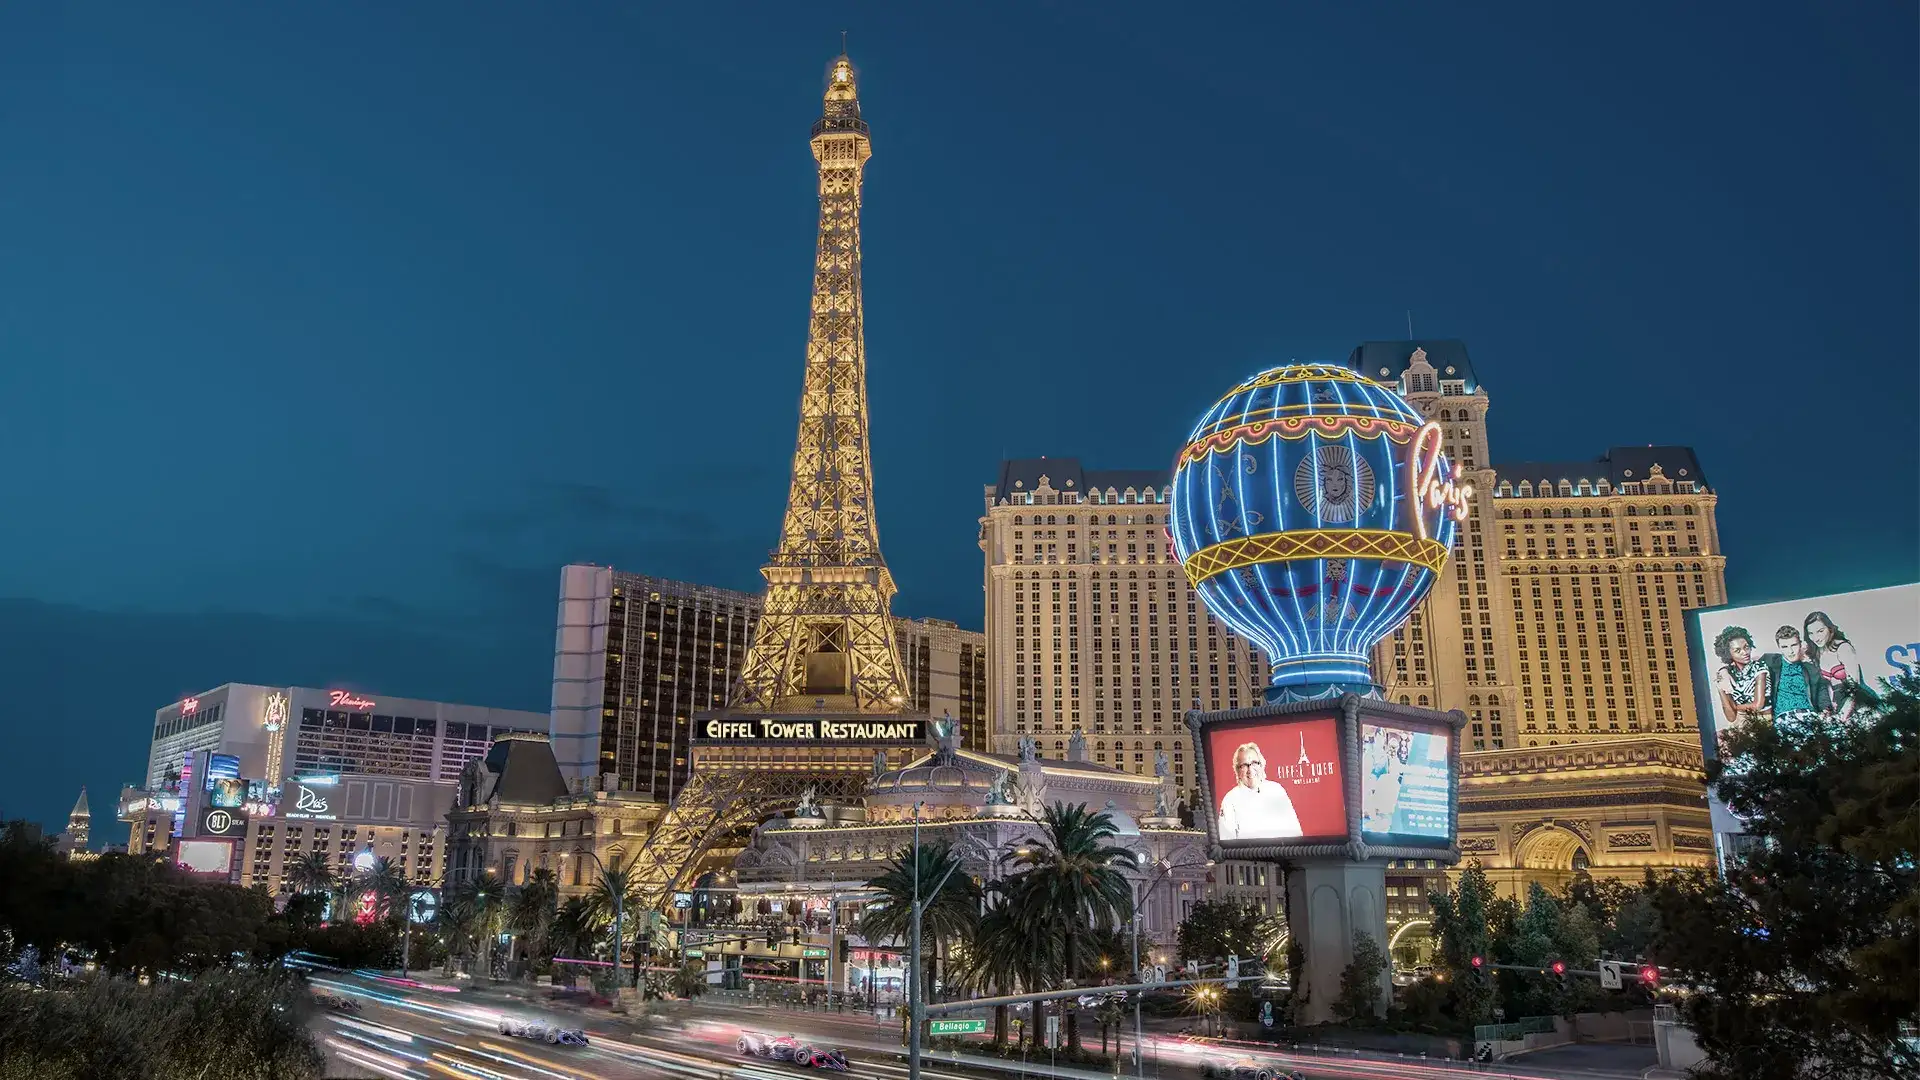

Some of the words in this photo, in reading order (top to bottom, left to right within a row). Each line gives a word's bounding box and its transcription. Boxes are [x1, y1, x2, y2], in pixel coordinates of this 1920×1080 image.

[1412, 422, 1473, 540] Paris
[329, 690, 376, 710] Flamingo
[706, 720, 755, 738] EIFFEL
[761, 719, 814, 738] TOWER
[821, 721, 917, 738] RESTAURANT
[211, 815, 226, 829] BLT
[940, 1022, 970, 1032] Bellagio
